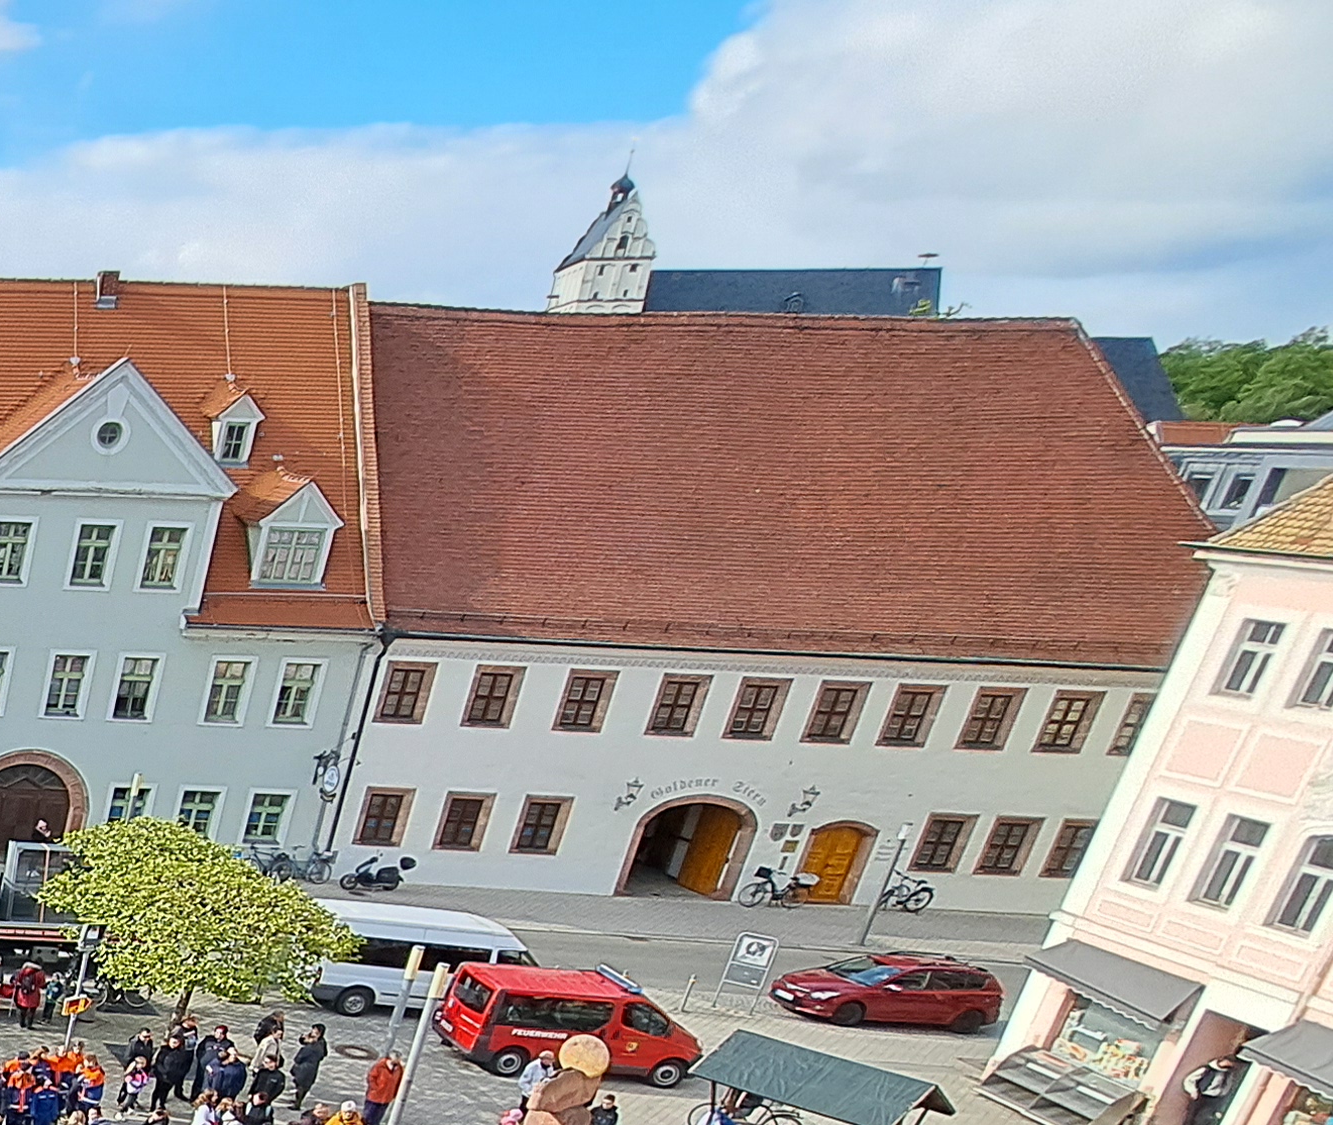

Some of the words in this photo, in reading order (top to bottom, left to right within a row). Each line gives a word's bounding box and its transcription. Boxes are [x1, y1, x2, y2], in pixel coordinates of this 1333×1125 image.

[650, 778, 719, 800] Goldener
[733, 781, 766, 807] Stern
[511, 1028, 568, 1040] FEUERWEHR
